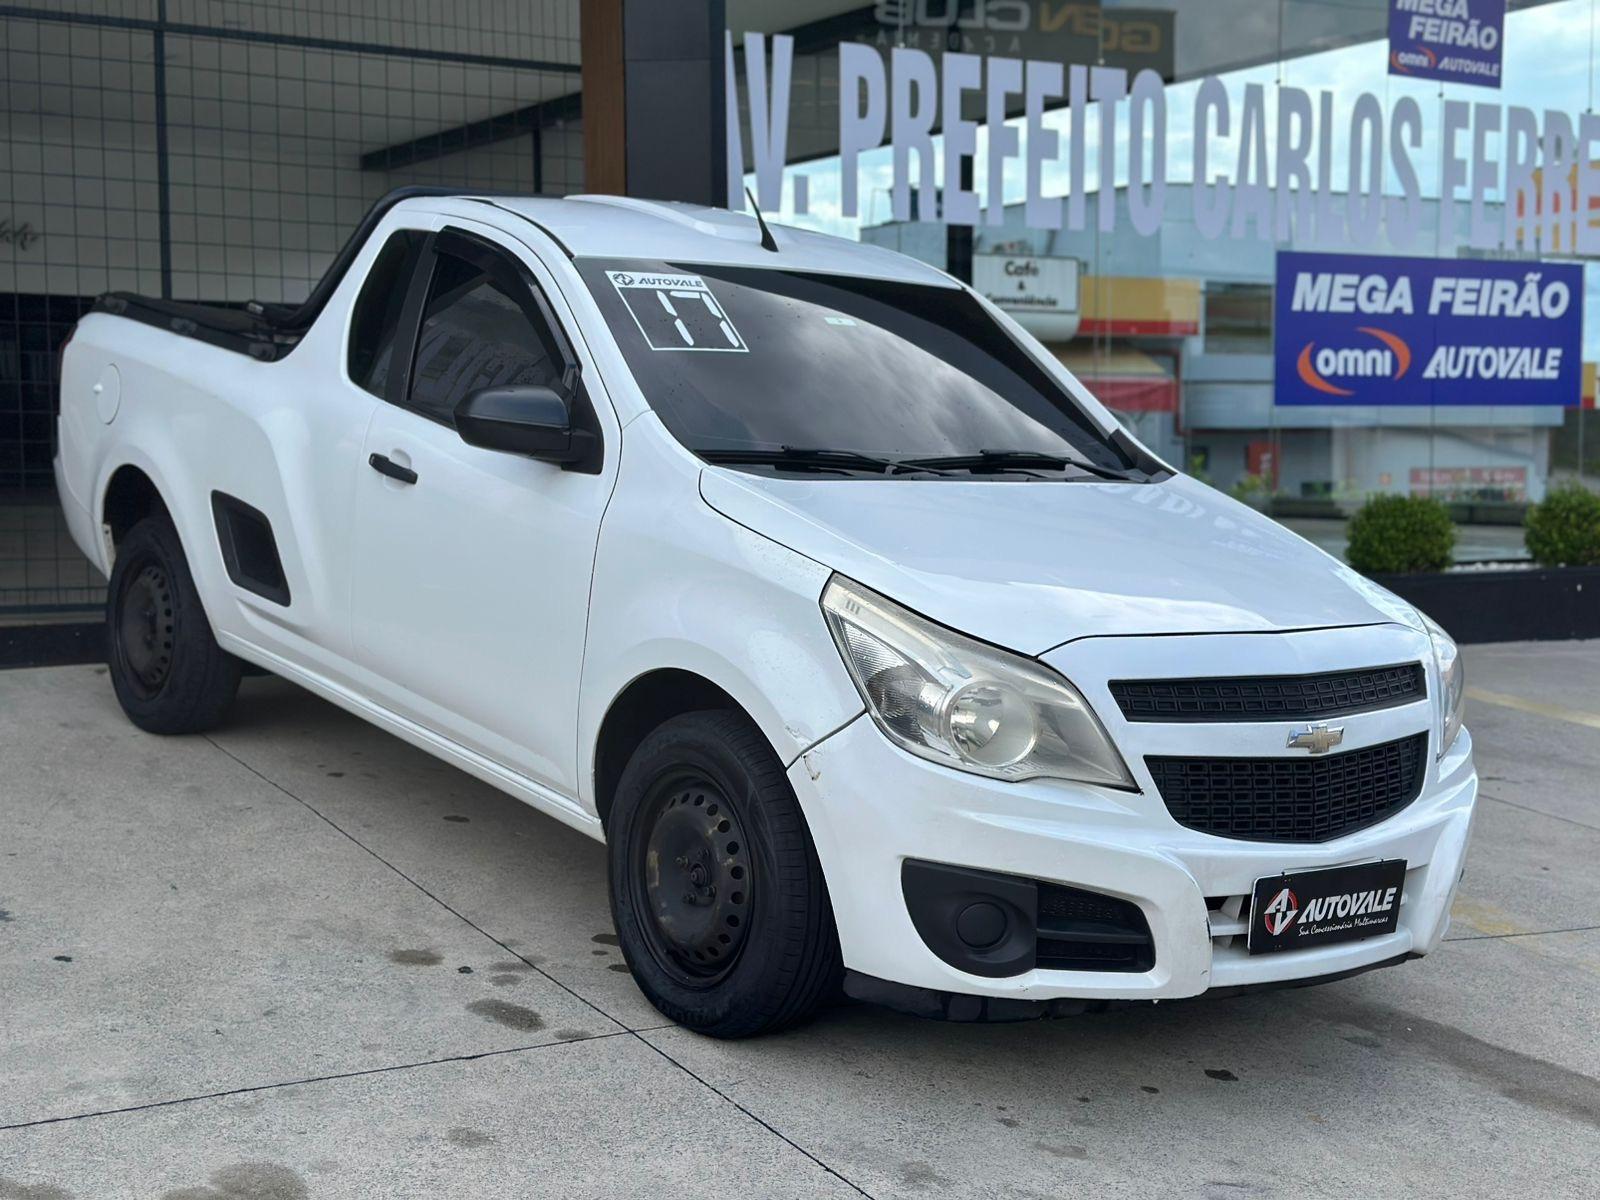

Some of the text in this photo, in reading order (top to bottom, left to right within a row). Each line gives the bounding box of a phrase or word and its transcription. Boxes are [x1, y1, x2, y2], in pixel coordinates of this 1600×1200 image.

[1408, 15, 1499, 51] FEIRÃO
[1398, 52, 1499, 77] omni AUTOVALE
[839, 41, 1168, 237] PREFEITO
[1193, 75, 1423, 250] CARLOS
[638, 277, 703, 288] AUTOVALE
[1292, 271, 1570, 319] MEGA FEIRÃO
[656, 290, 740, 348] 17
[1316, 345, 1562, 379] omni AUTOVALE
[1297, 887, 1397, 924] AUTOVALE
